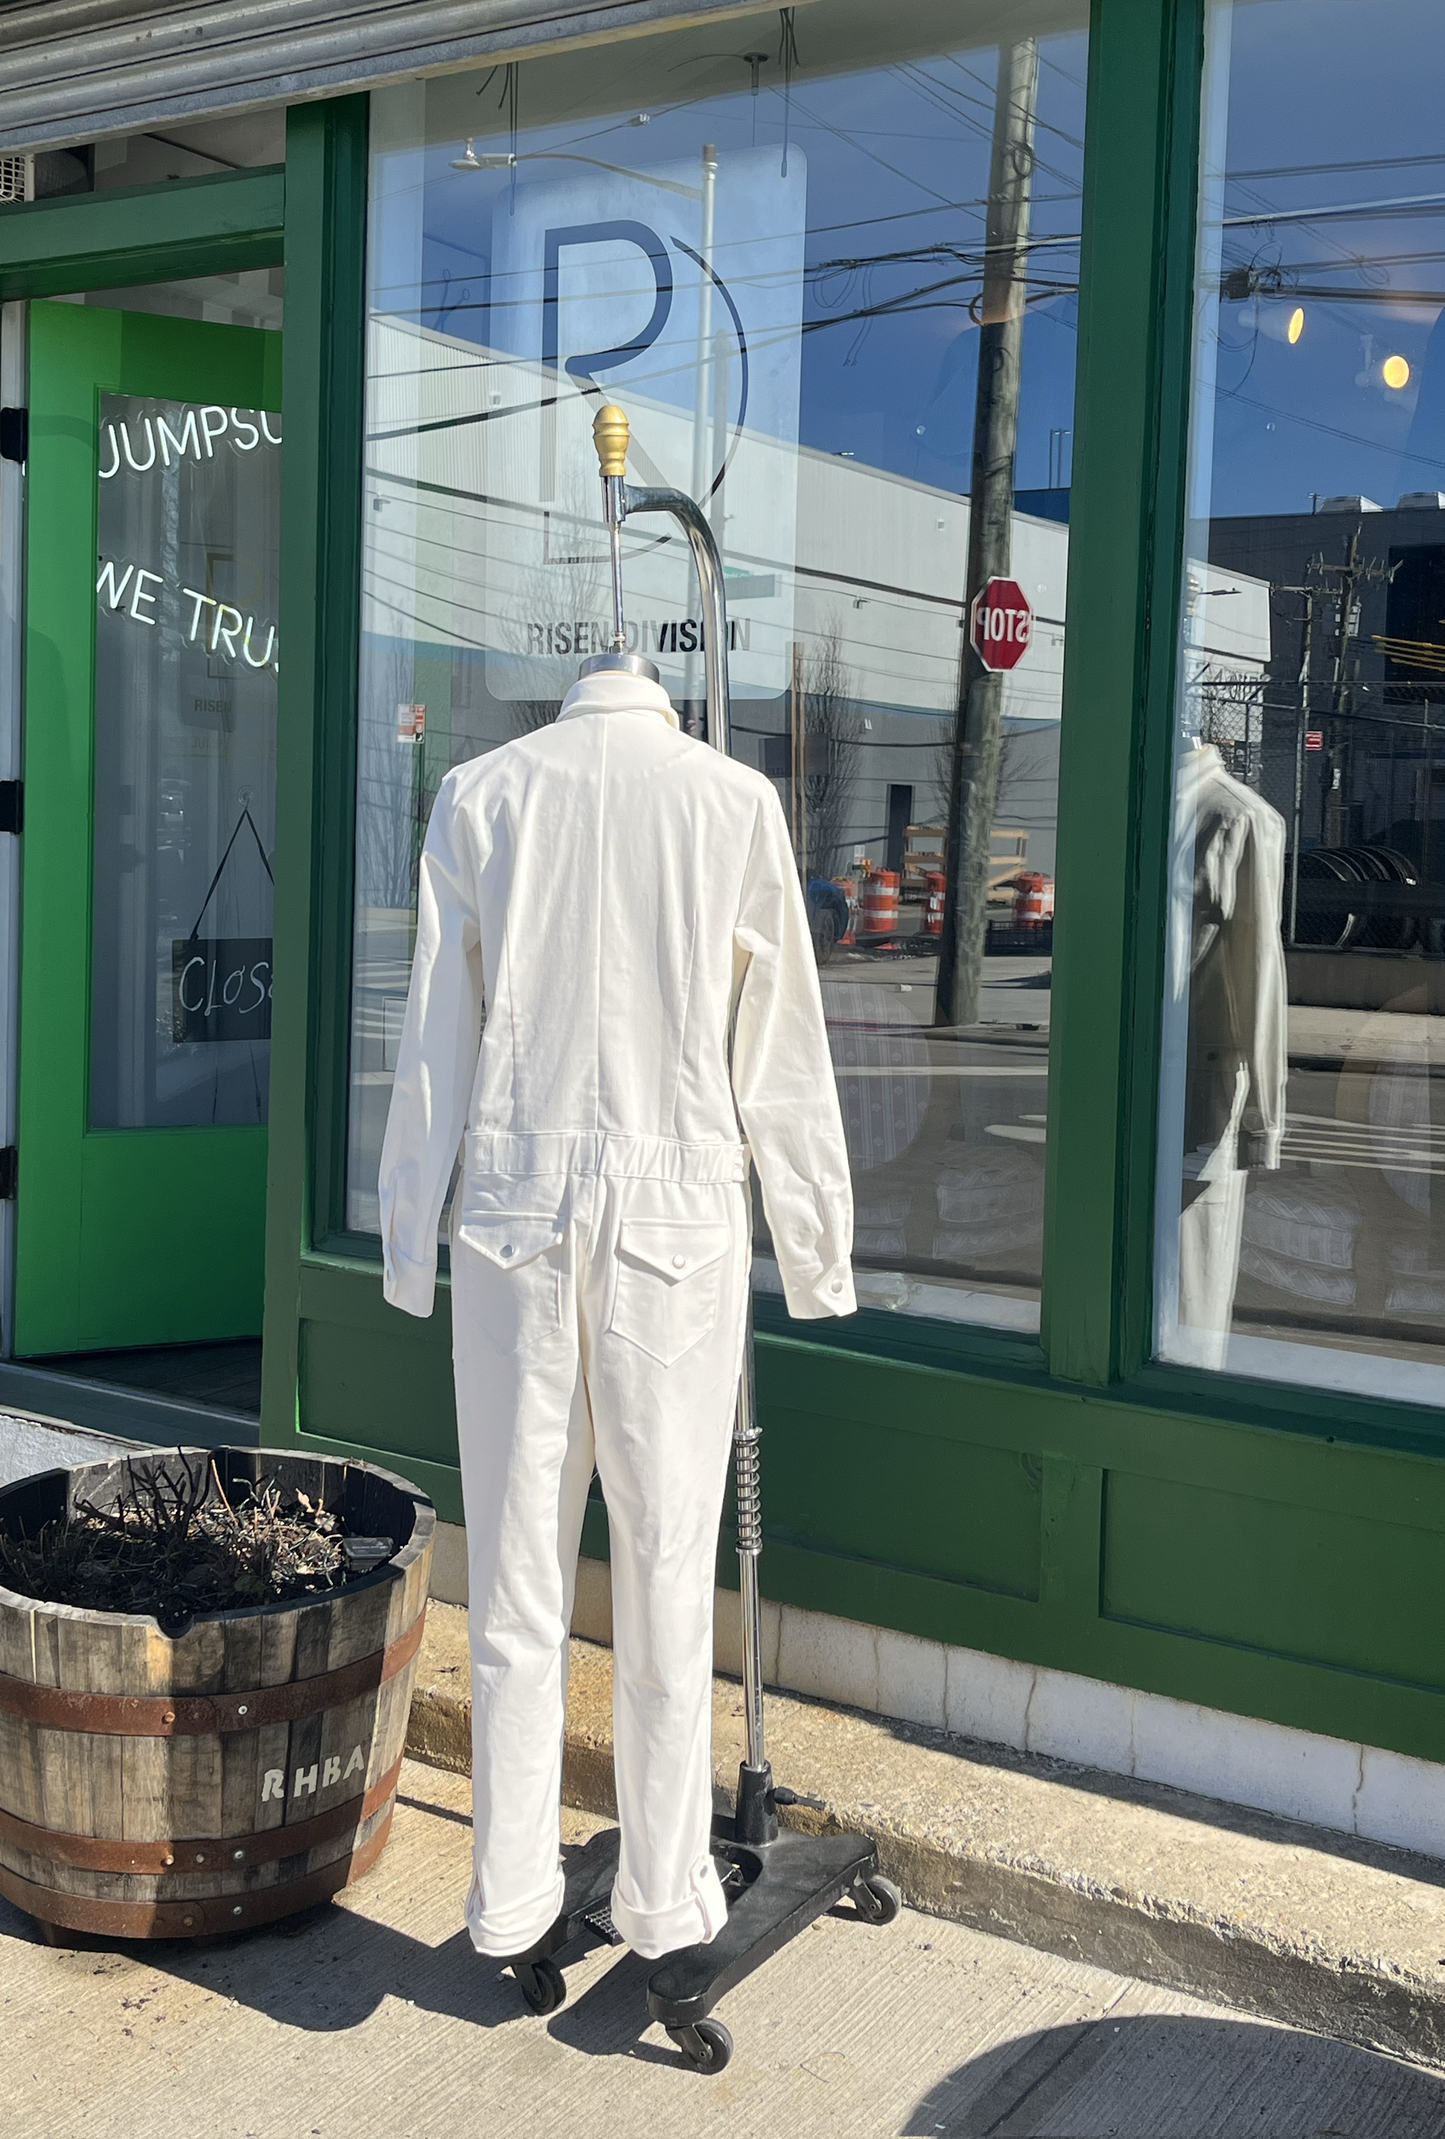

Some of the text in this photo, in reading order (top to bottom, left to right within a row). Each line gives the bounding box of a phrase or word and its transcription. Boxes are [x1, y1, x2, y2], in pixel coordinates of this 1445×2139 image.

[183, 588, 279, 672] TRU
[527, 618, 750, 655] RISEN DIVISIN
[194, 699, 232, 713] RISEN
